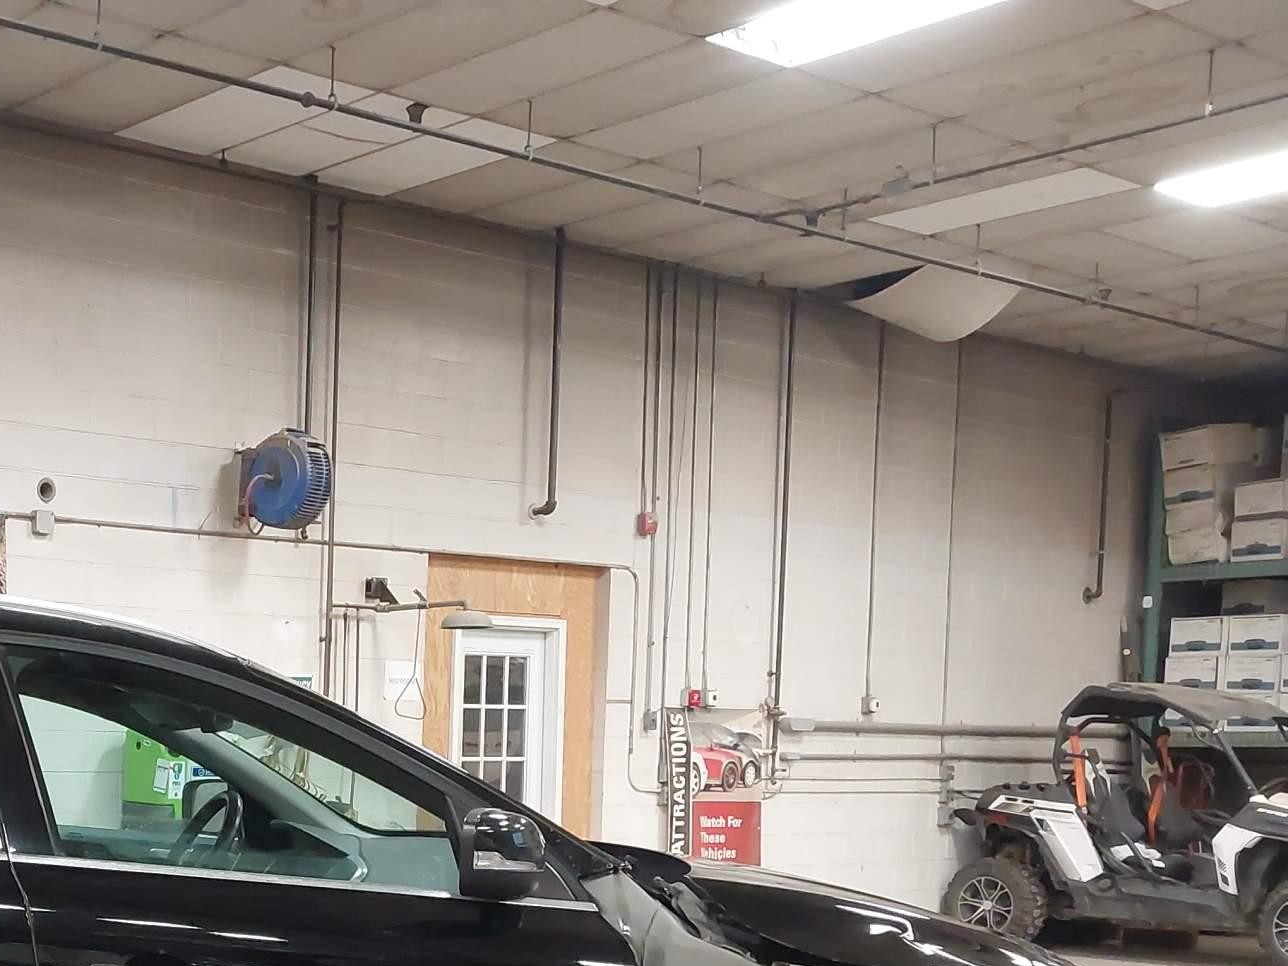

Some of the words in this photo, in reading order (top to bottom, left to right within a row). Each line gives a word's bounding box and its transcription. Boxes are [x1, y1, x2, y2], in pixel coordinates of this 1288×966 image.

[670, 713, 688, 856] ATTRACTIONS
[699, 815, 725, 828] Watch
[727, 815, 743, 828] For
[699, 831, 726, 844] These
[700, 847, 737, 860] Vehicles
